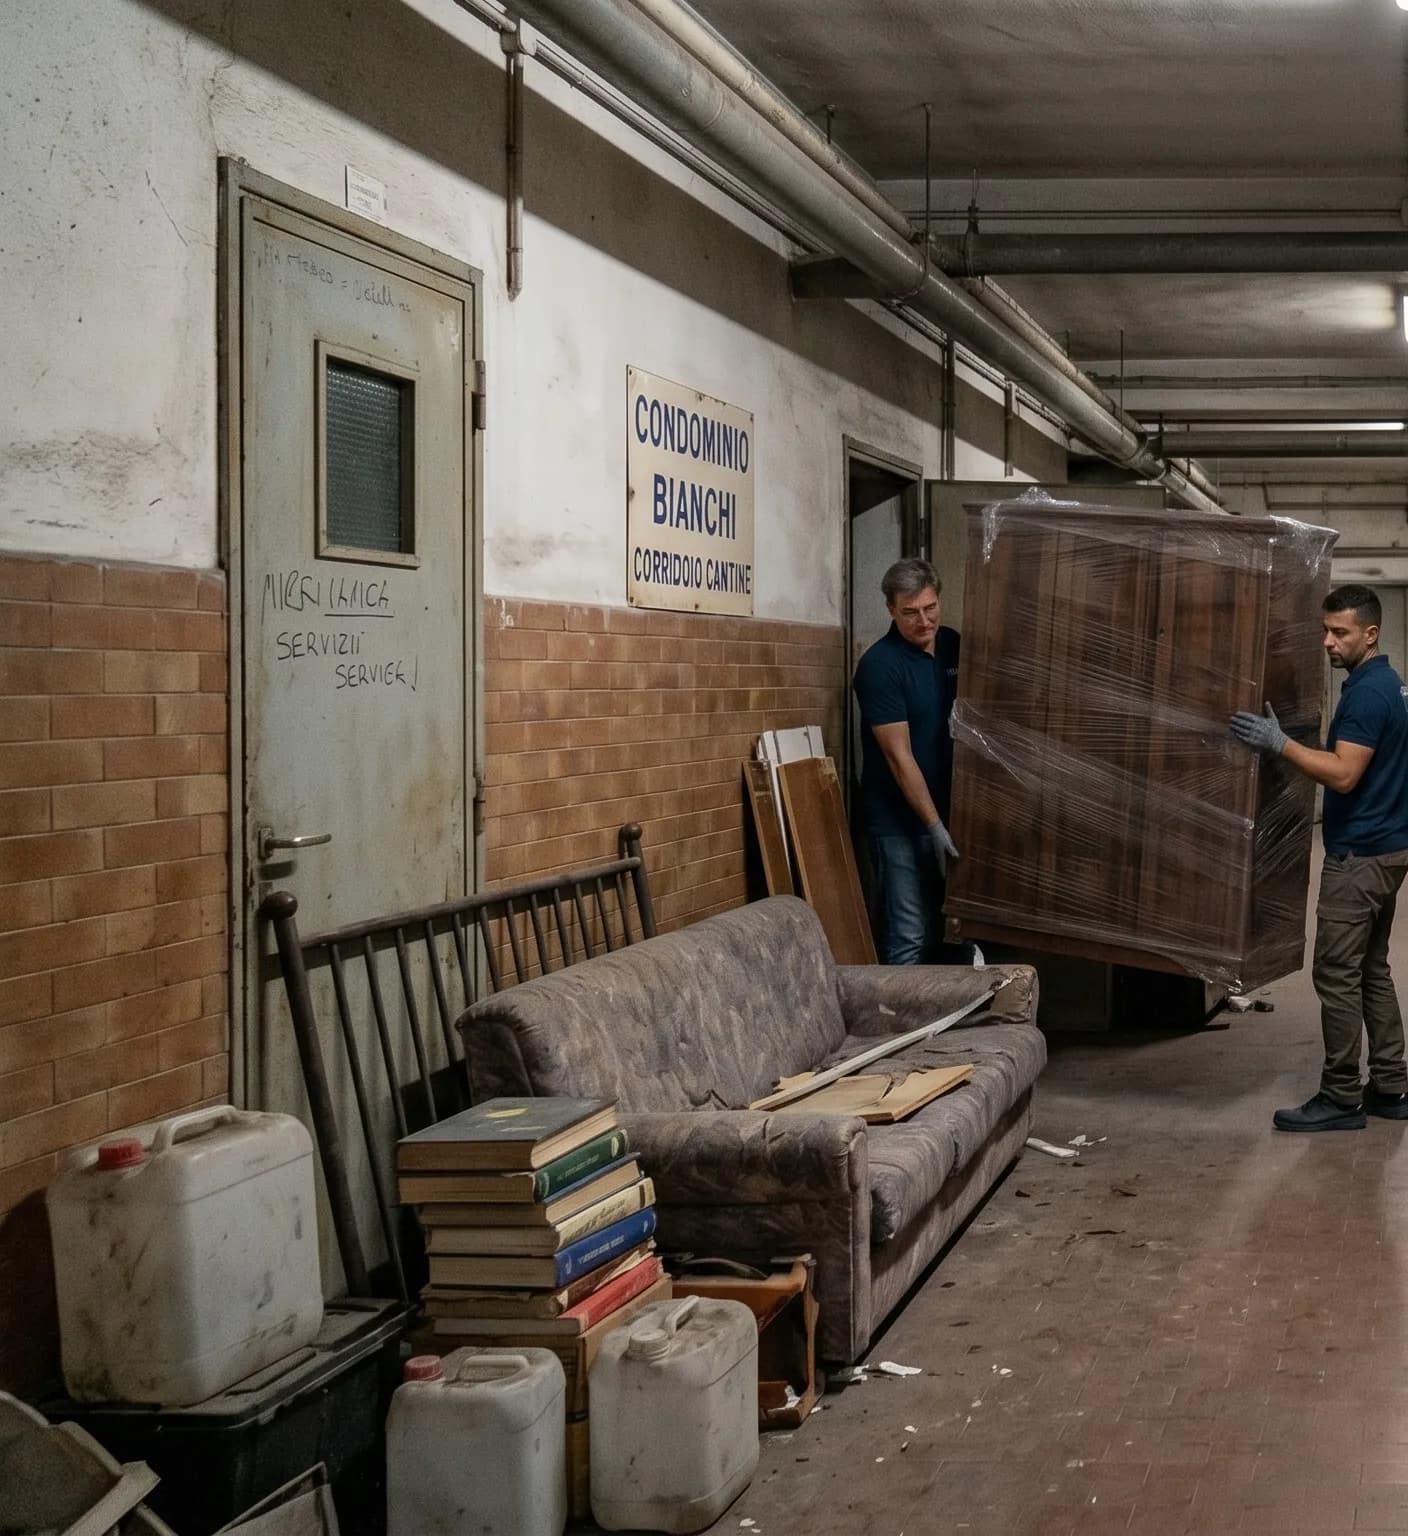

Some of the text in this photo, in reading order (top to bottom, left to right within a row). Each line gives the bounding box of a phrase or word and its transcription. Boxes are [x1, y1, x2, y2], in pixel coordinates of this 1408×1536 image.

[635, 394, 749, 474] CONDOMINIO
[653, 473, 736, 540] BIANCHI
[634, 547, 751, 594] CORRIDOIO CANTINE
